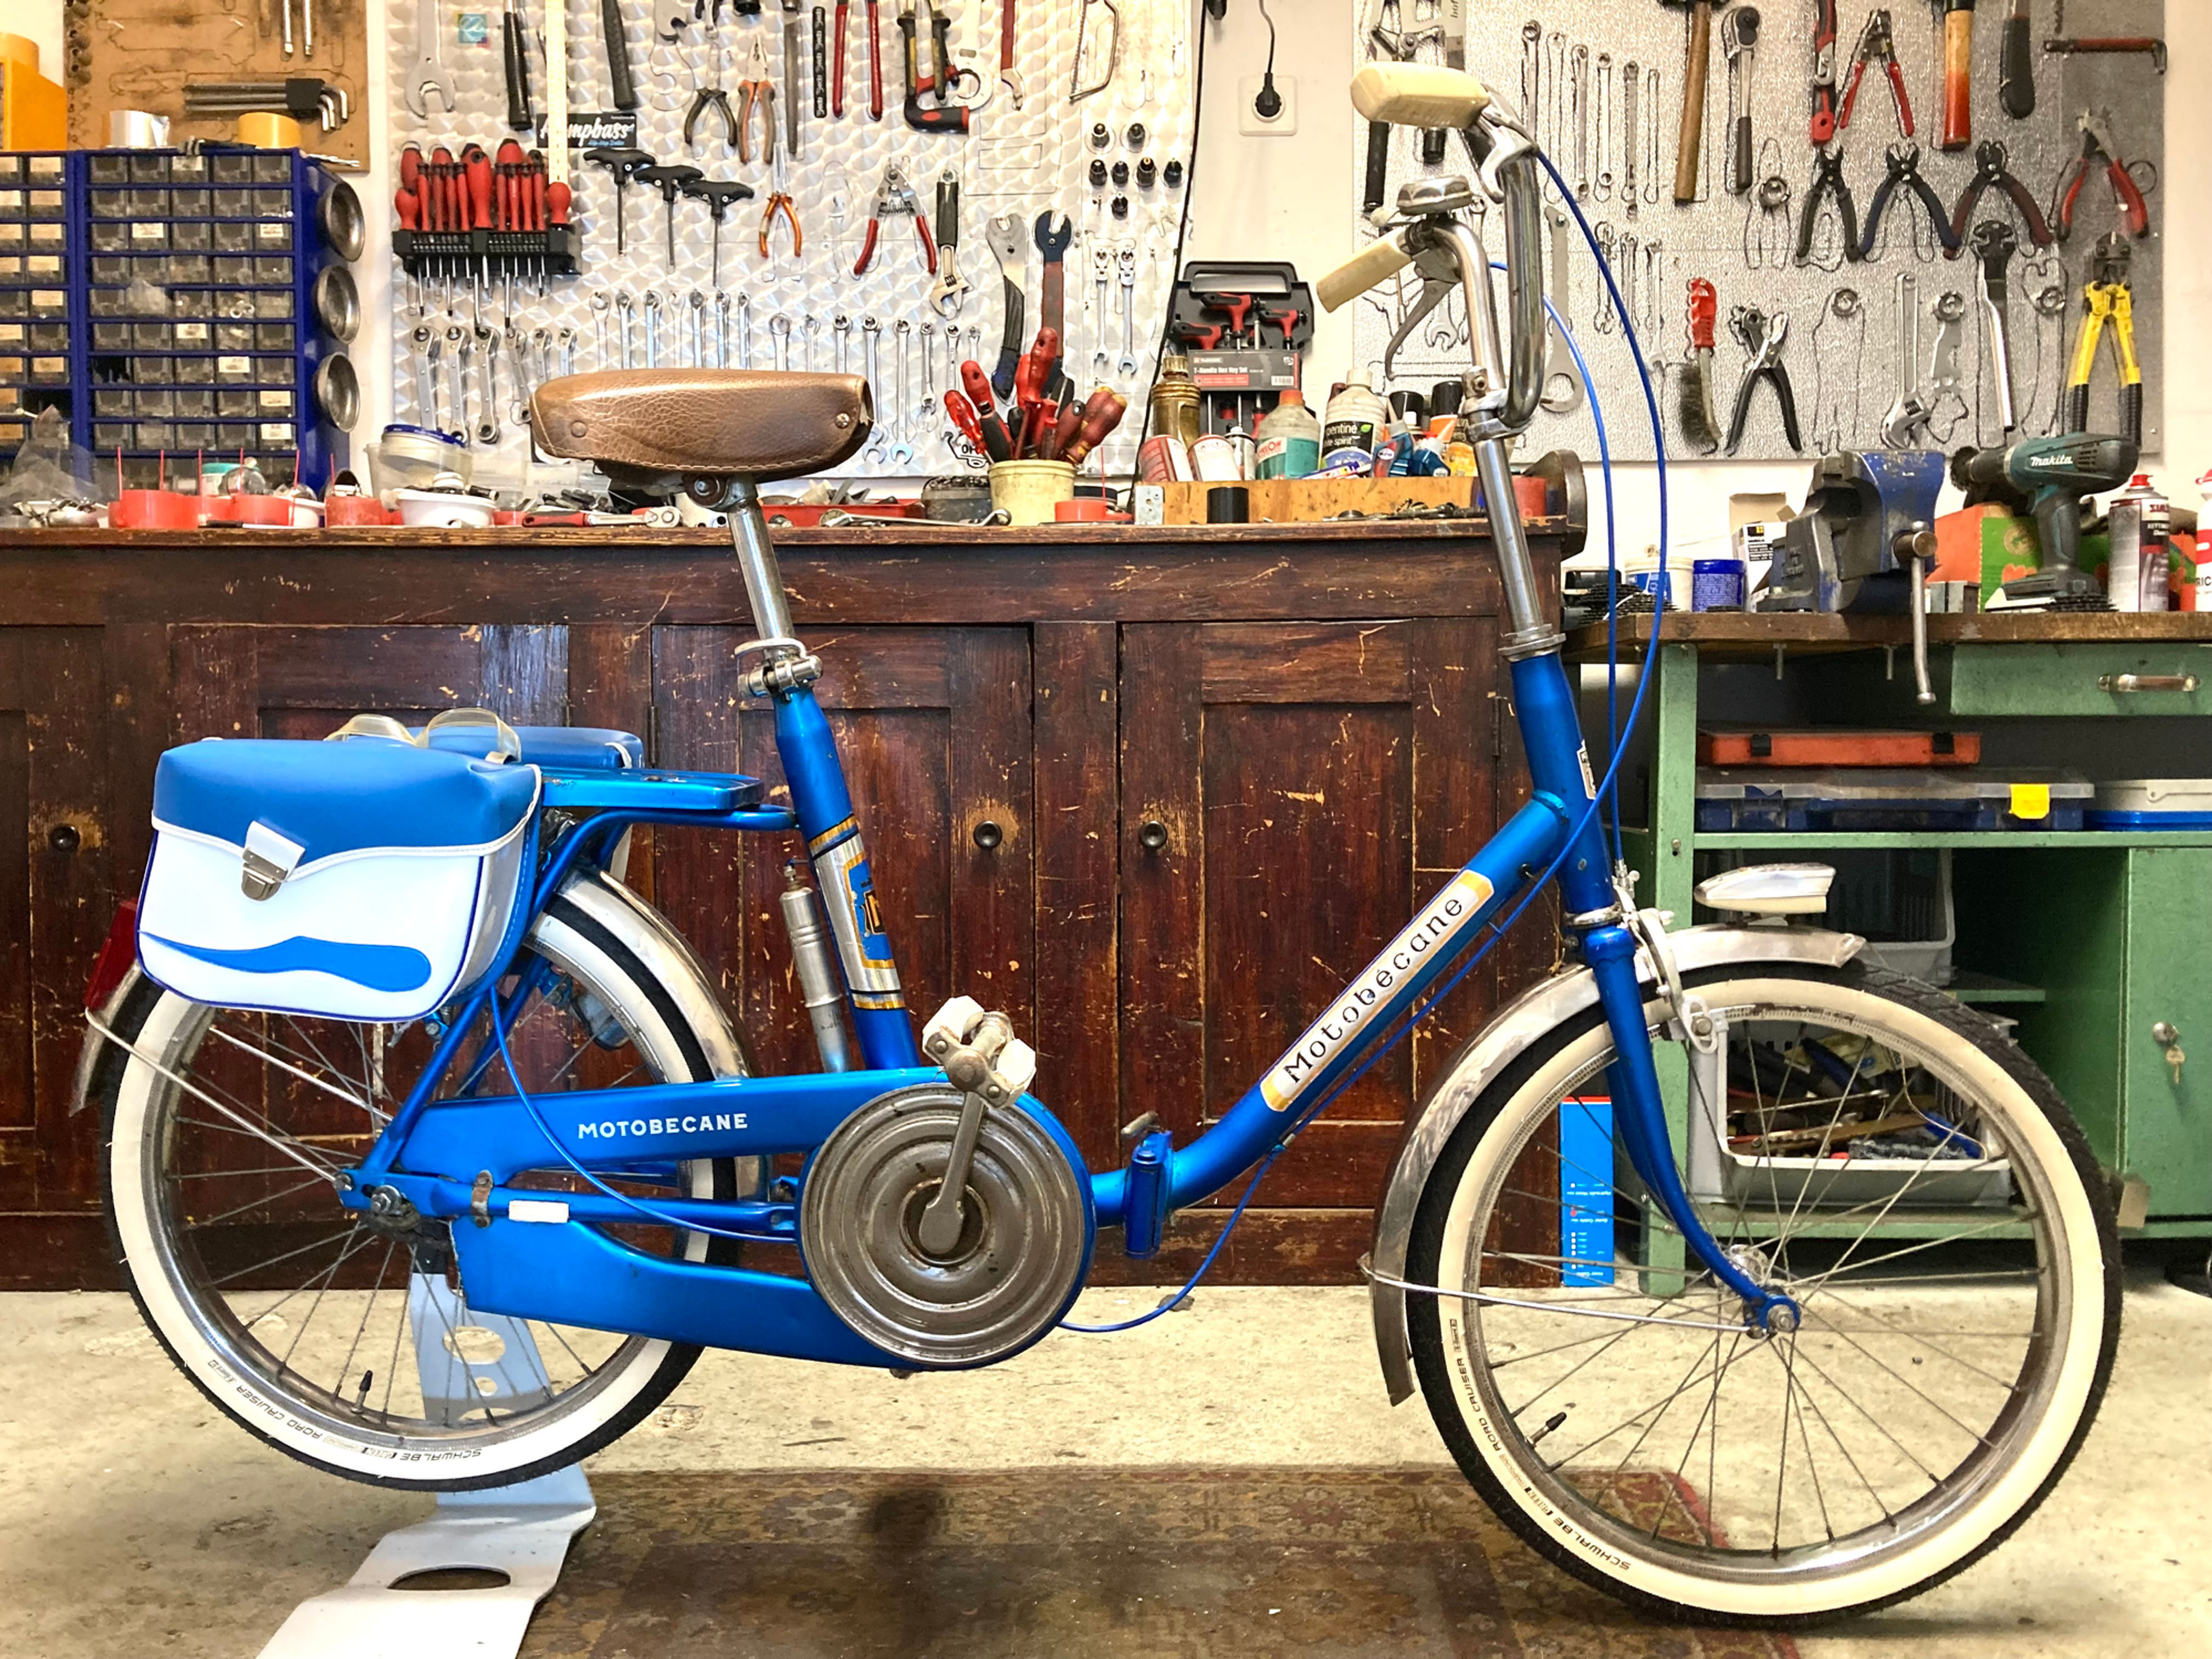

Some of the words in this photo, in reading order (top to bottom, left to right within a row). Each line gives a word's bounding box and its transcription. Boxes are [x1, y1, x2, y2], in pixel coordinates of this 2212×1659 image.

[1284, 896, 1463, 1084] Motobécane
[578, 1113, 748, 1139] MOTOBECANE
[236, 1384, 285, 1420] CRUISER
[1456, 1358, 1481, 1412] CRUISER
[286, 1419, 323, 1439] ROAD
[1479, 1418, 1502, 1451] ROAD
[400, 1448, 483, 1462] SCHWALBE
[1553, 1517, 1632, 1570] SCHWALBE
